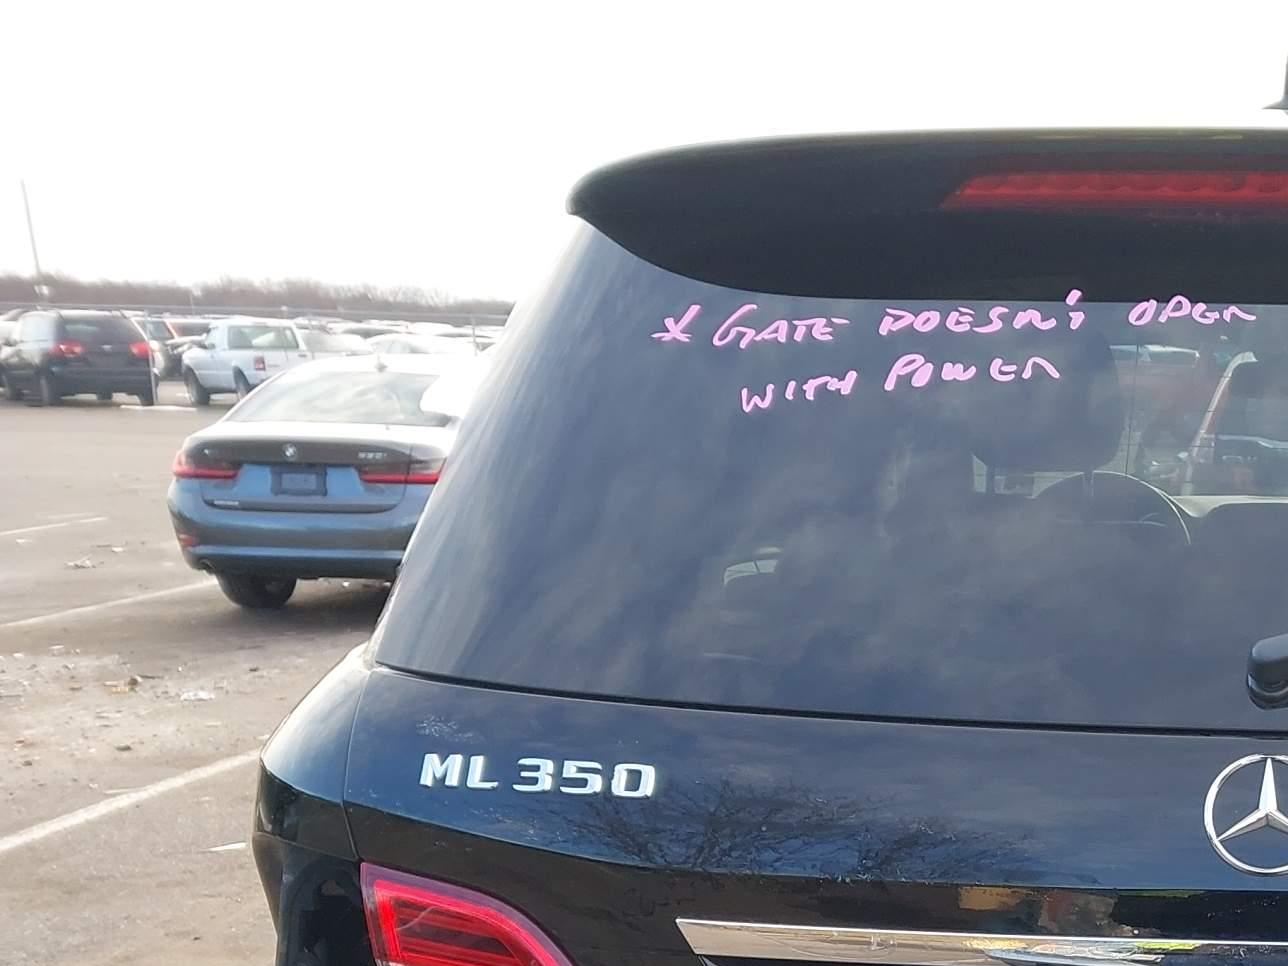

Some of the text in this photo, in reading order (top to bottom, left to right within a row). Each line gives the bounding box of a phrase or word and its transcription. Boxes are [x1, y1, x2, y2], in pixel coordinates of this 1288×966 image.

[713, 304, 851, 349] GATE
[1128, 294, 1257, 326] OPEN
[740, 353, 1061, 412] WITH POWER
[419, 753, 656, 798] ML 350
